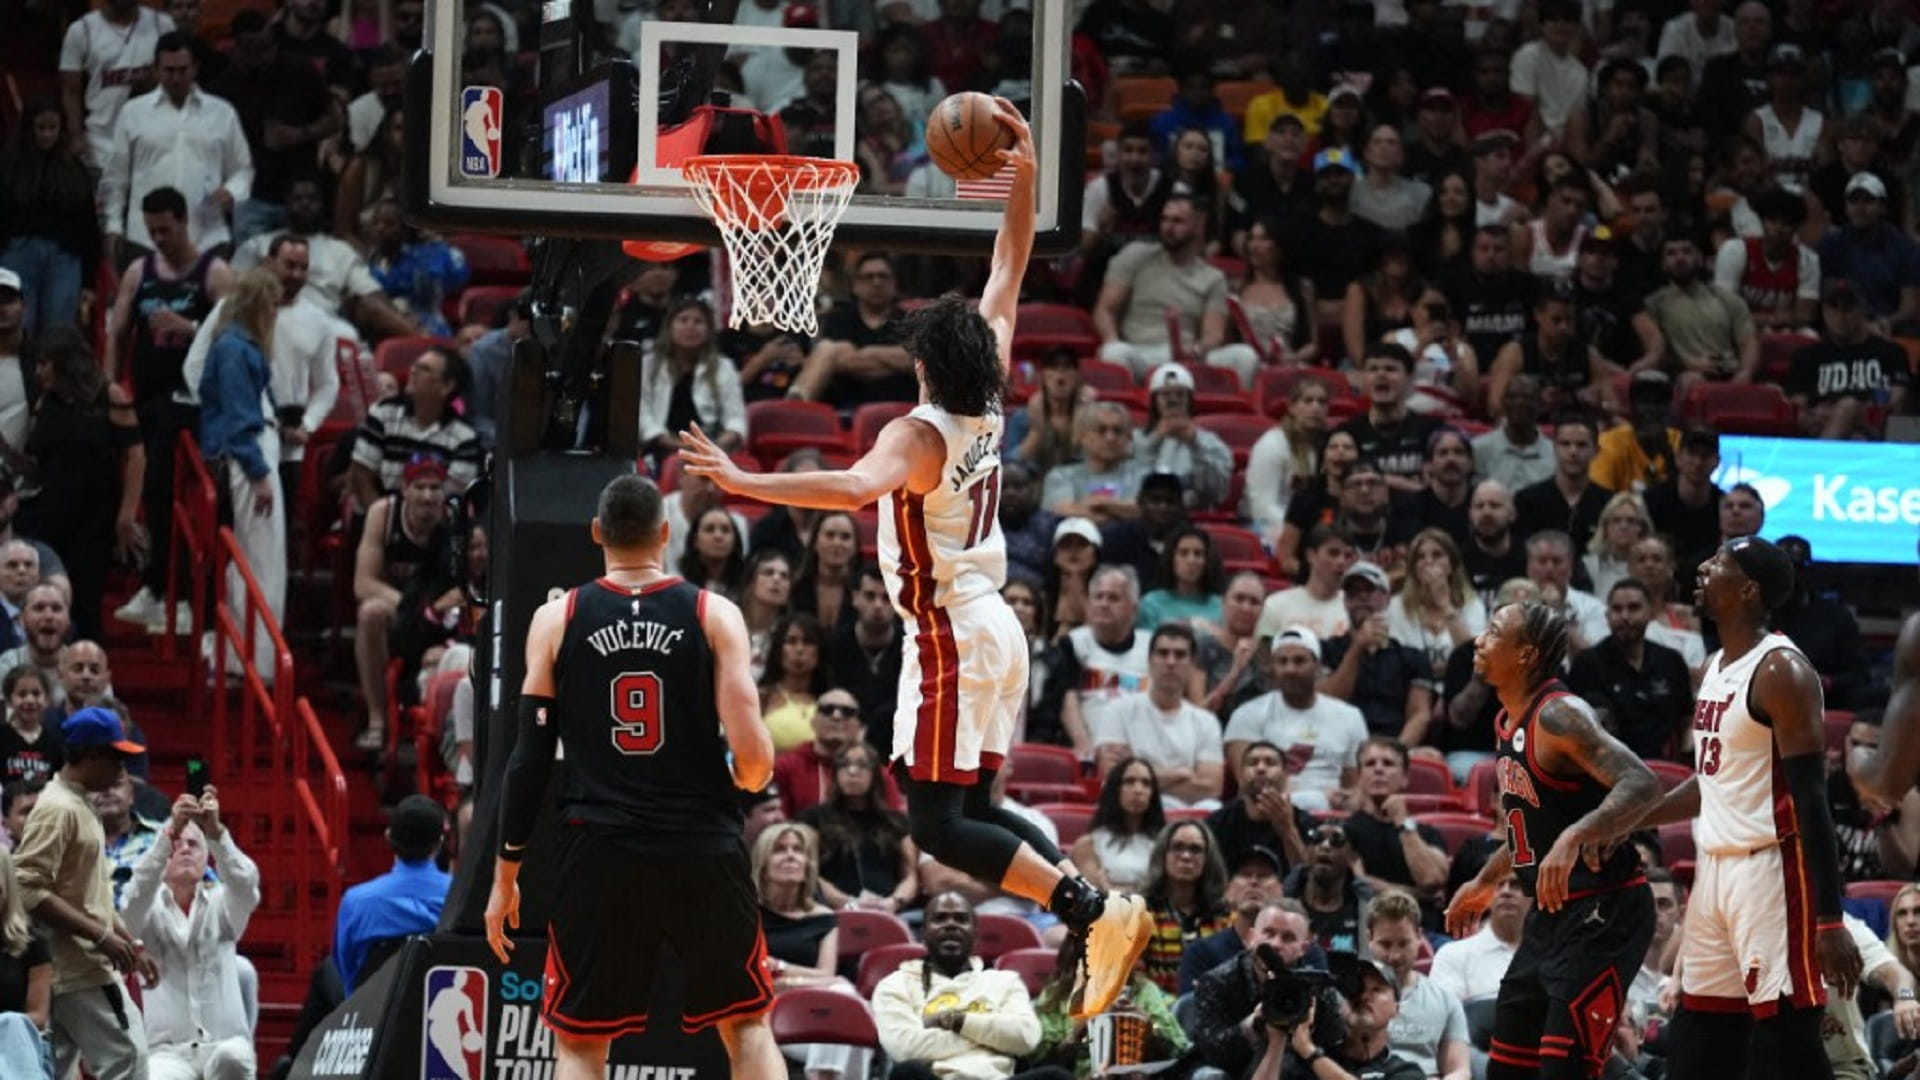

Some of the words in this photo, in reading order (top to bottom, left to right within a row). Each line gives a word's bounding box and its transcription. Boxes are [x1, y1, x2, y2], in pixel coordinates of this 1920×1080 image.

[963, 465, 998, 550] 11
[587, 618, 685, 658] VUČEVIĆ
[611, 671, 664, 755] 9
[1698, 736, 1722, 776] 13
